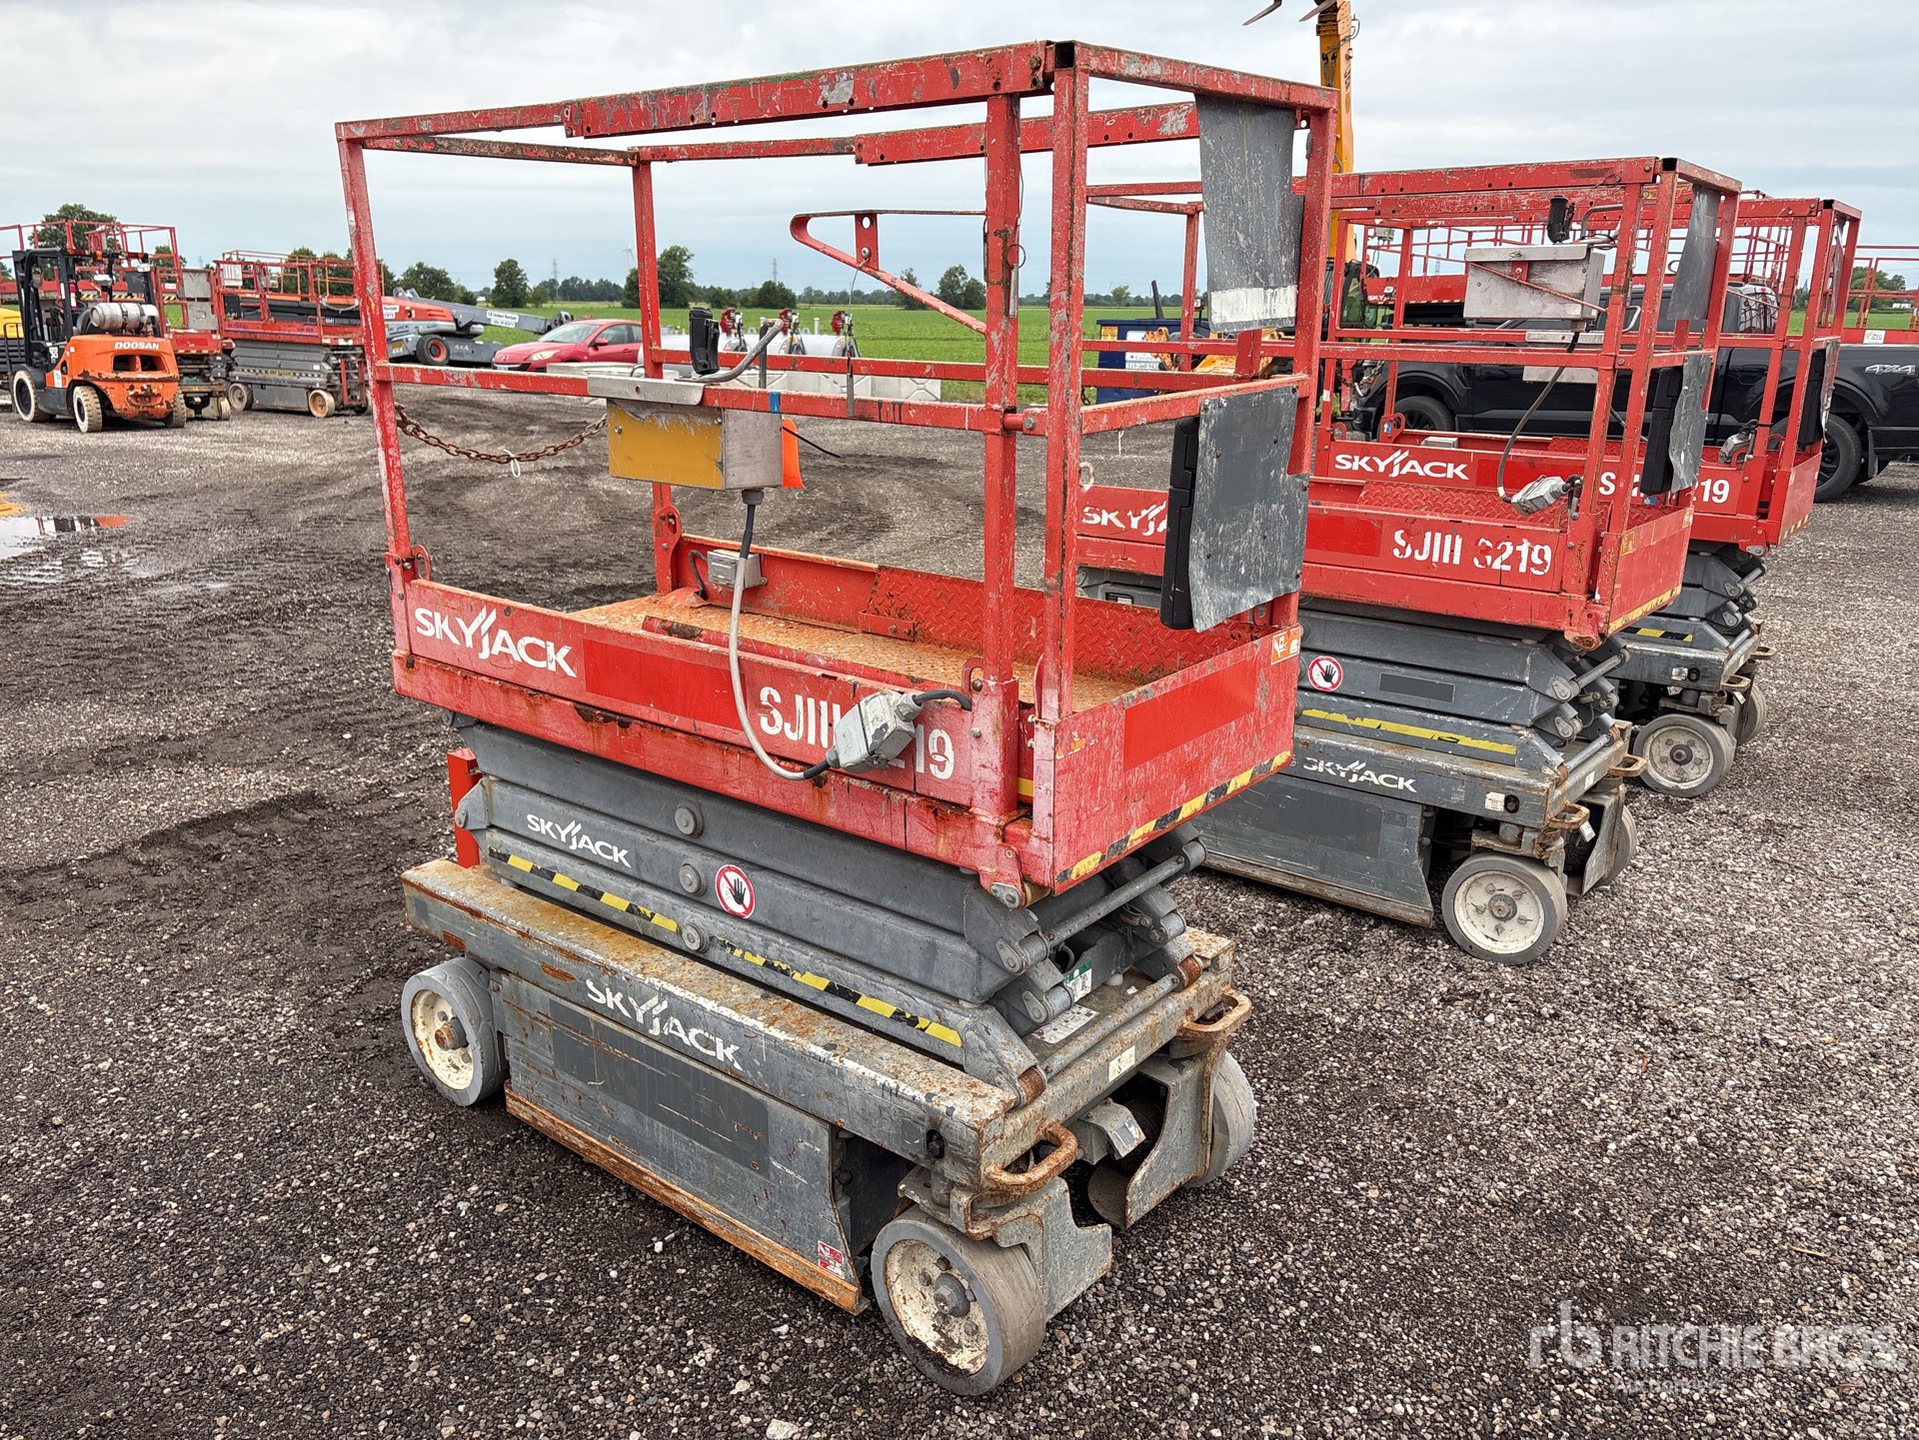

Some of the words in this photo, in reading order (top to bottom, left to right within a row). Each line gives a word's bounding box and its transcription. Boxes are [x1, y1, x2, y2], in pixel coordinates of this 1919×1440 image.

[114, 341, 159, 350] DOOSAN
[1334, 449, 1470, 481] SKYJACK
[1472, 537, 1552, 576] 3219
[414, 606, 578, 678] SKYJACK
[1303, 757, 1418, 794] SKYJACK
[526, 813, 632, 869] SKYJACK
[585, 978, 744, 1072] SKYJACK
